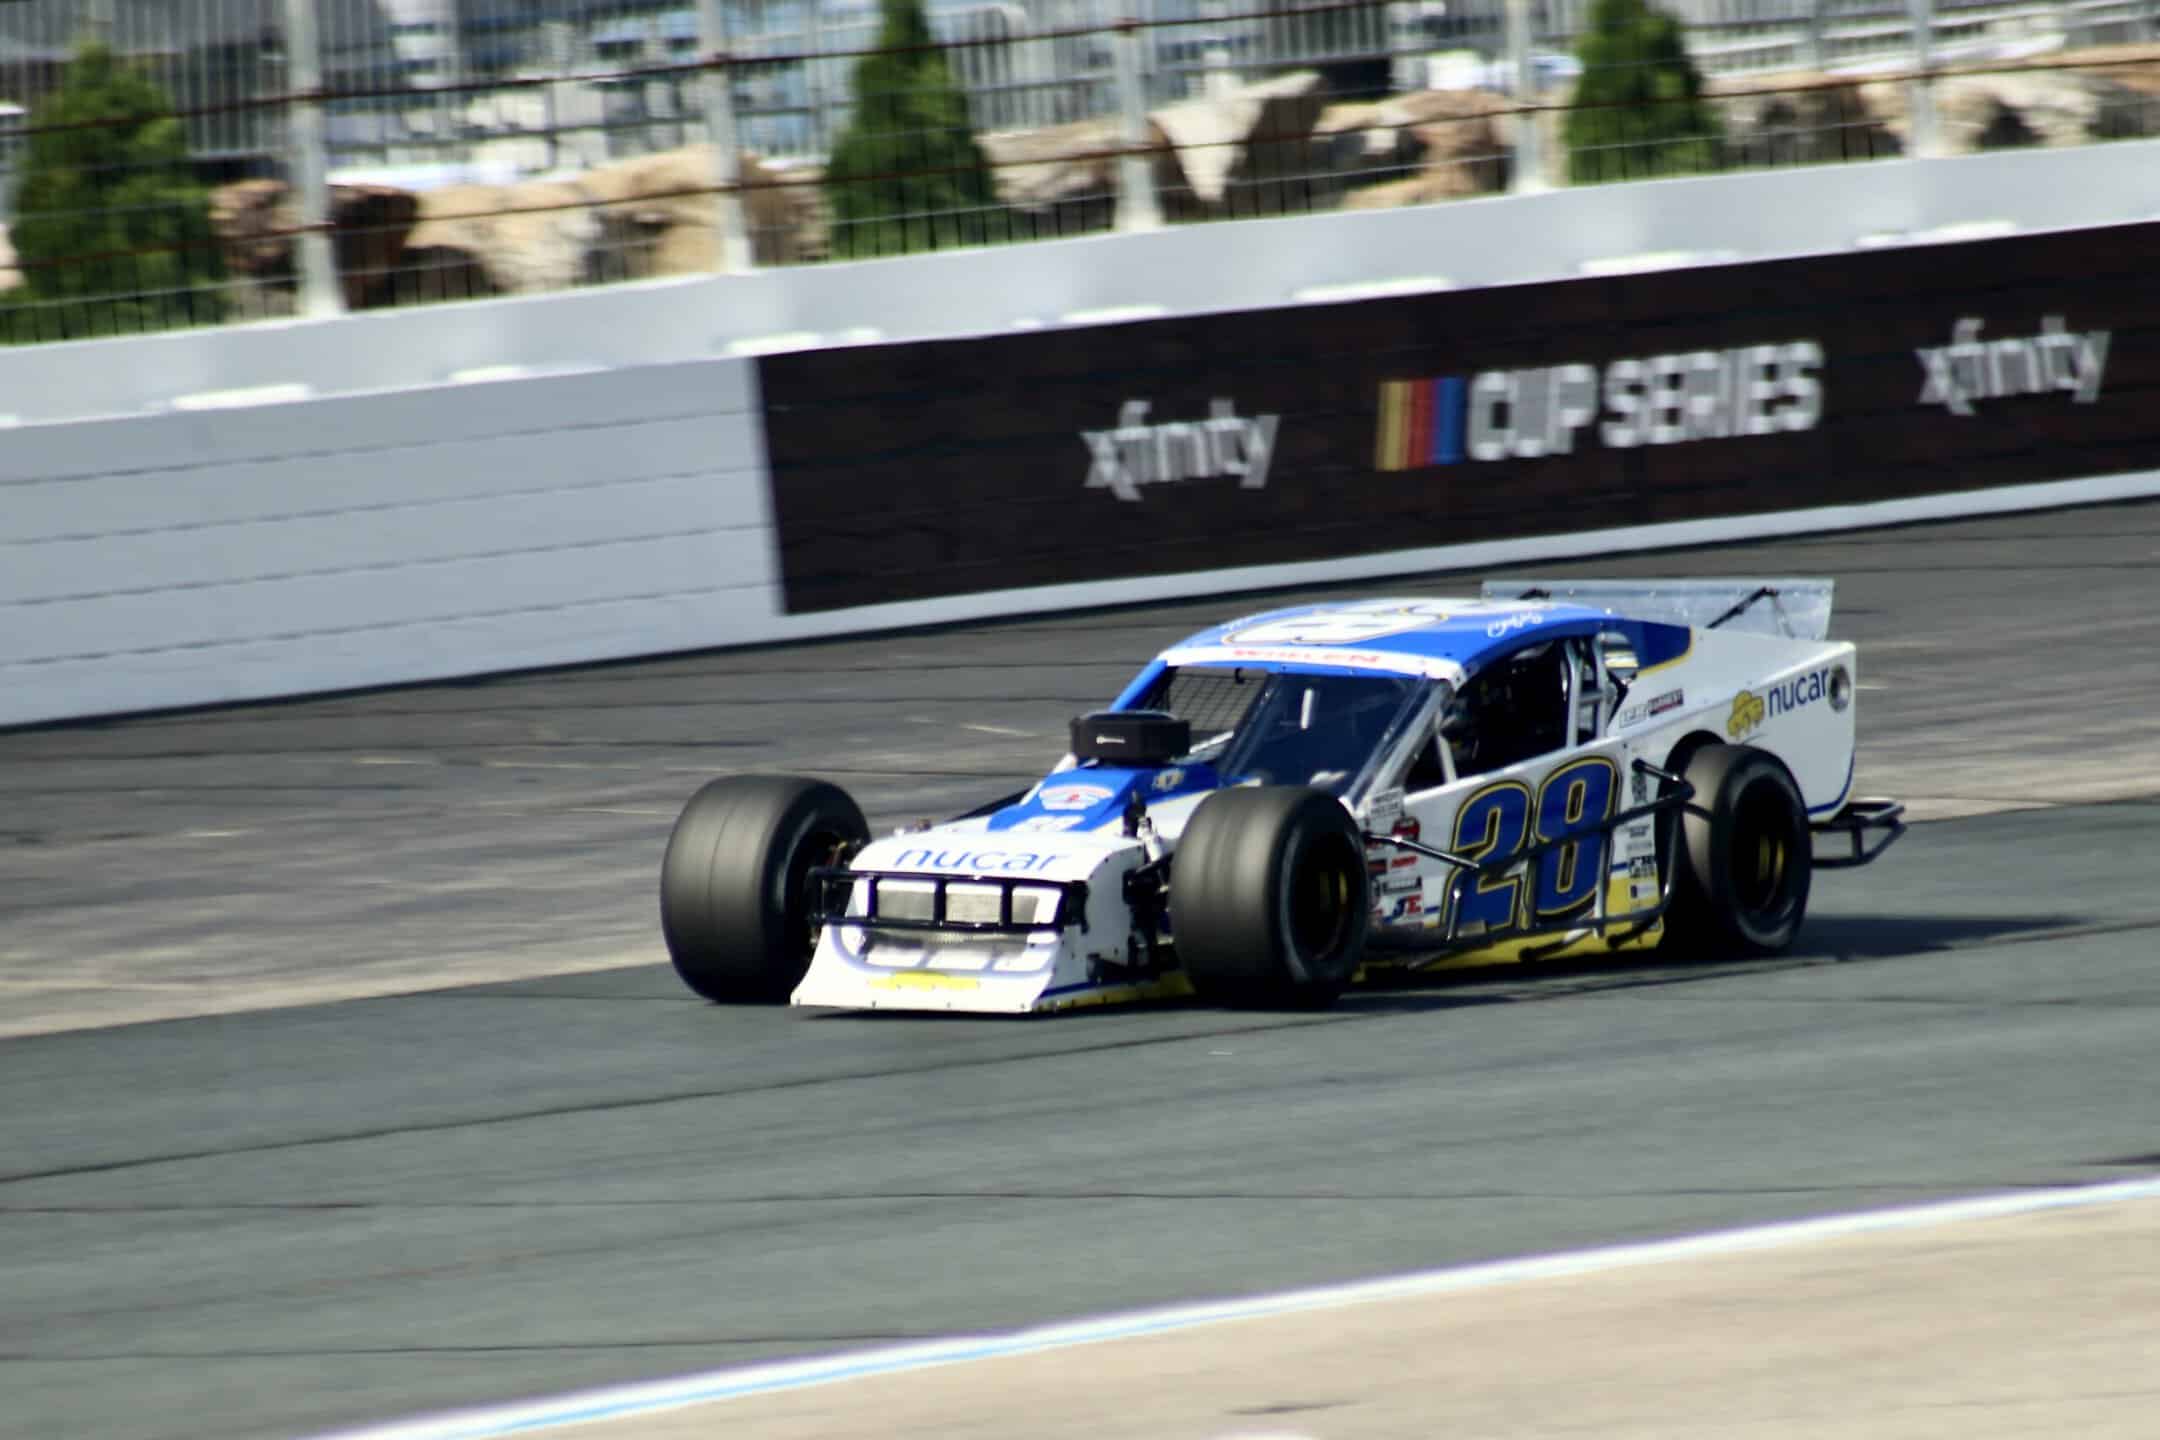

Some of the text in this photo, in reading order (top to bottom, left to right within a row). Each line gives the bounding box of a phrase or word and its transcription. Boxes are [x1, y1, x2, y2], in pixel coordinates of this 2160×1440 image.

[1469, 341, 1825, 461] CUP SERIES
[1914, 316, 2112, 416] xfinity
[1079, 397, 1280, 501] xfinity
[1768, 667, 1830, 717] nucar
[893, 846, 1072, 873] nucar
[1440, 756, 1621, 932] 28
